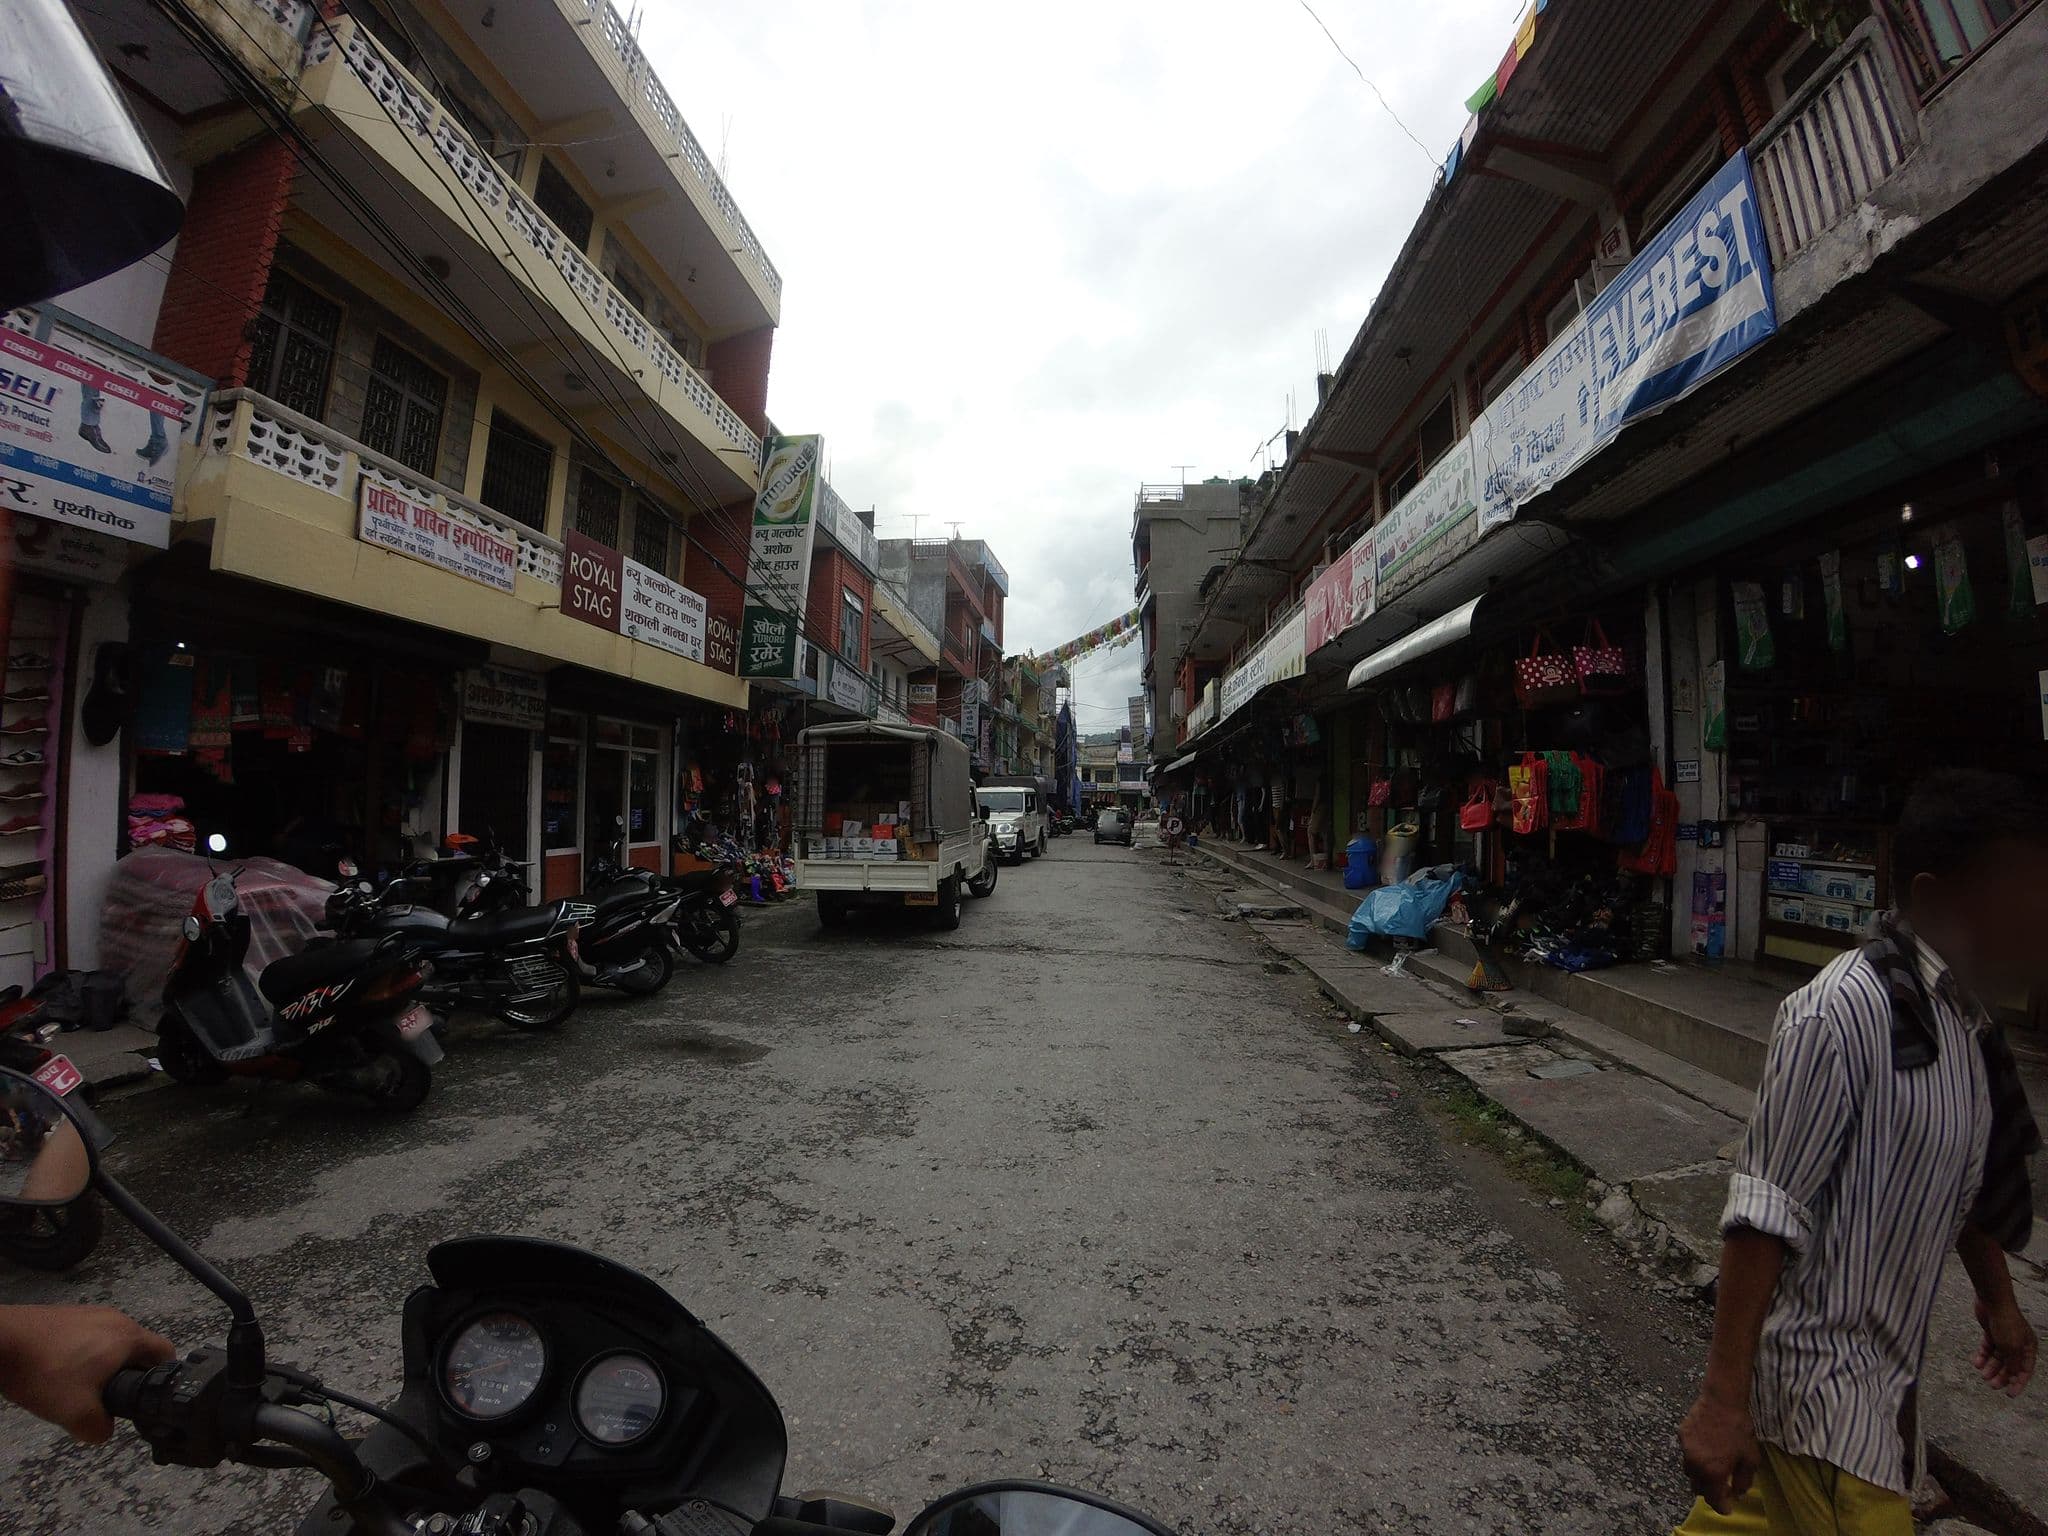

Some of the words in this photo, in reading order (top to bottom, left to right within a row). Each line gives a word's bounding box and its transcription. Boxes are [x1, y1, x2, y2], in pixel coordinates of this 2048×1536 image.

[1588, 180, 1759, 388] EVEREST
[3, 339, 44, 361] COSELI
[54, 359, 94, 381] COSELI
[104, 381, 140, 399] COSELI
[11, 405, 50, 428] Product
[151, 400, 184, 418] COSELI
[760, 455, 808, 509] TUBORG
[367, 486, 409, 523] प्रदिप
[412, 505, 450, 541] प्रविन
[453, 524, 515, 568] इम्पोरियम
[763, 543, 793, 556] अशोक
[570, 551, 617, 592] ROYAL
[774, 560, 799, 571] हाउस
[626, 566, 643, 587] न्यू
[644, 574, 676, 602] गल्कोट
[679, 591, 704, 614] अशोक
[573, 584, 612, 619] STAG
[655, 600, 679, 621] हाउस
[707, 616, 735, 645] ROYAL
[752, 633, 785, 644] TUBORG
[690, 636, 704, 651] घर
[710, 641, 732, 665] STAG
[1171, 820, 1179, 831] P
